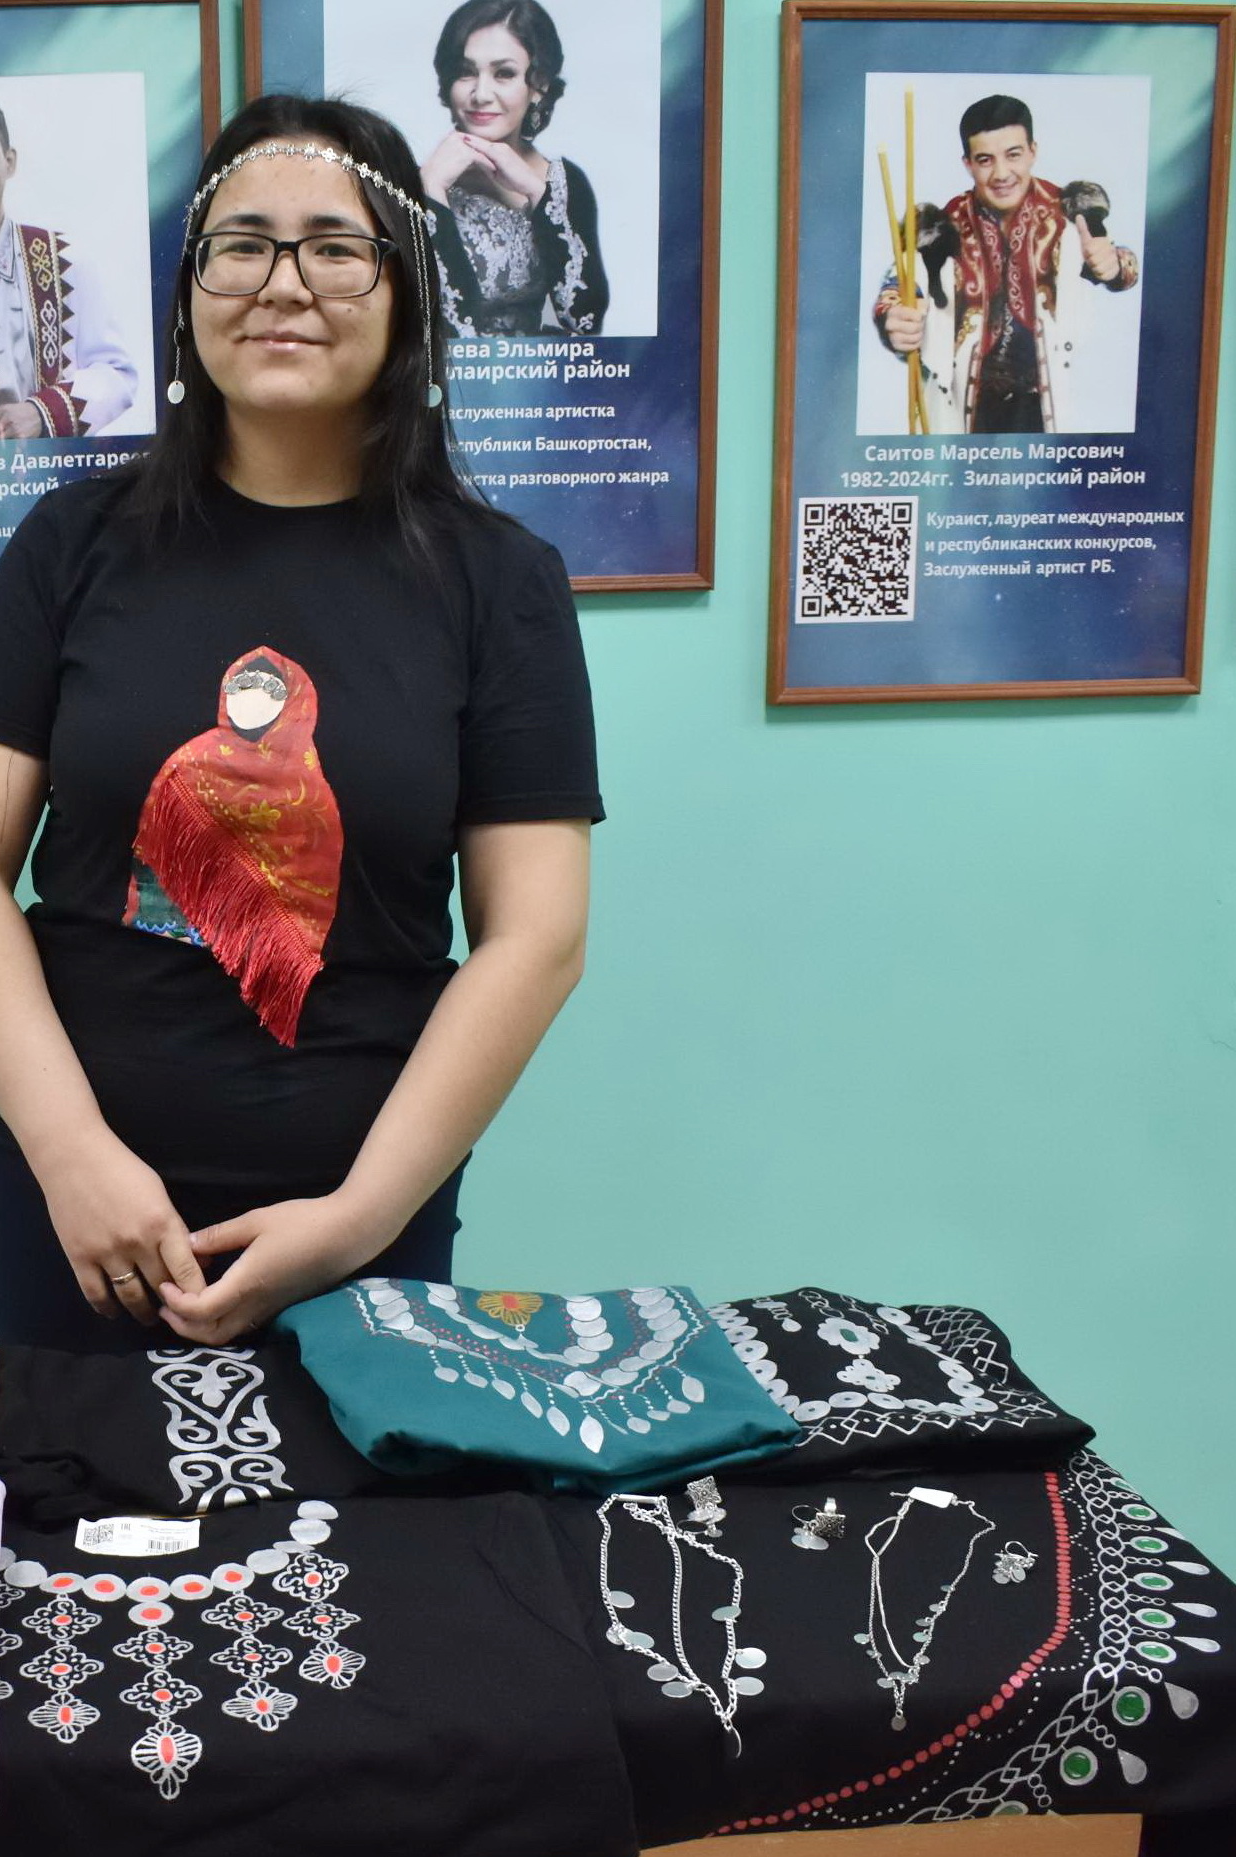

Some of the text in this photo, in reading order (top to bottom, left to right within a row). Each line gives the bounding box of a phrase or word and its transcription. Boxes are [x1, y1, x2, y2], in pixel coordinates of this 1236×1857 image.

[497, 340, 596, 362] Эльмира
[564, 359, 630, 383] район
[545, 405, 616, 421] артистка
[535, 436, 652, 453] Башкортостан,
[864, 443, 1125, 464] Саитов Марсель Марсович
[510, 472, 616, 488] разговорного
[618, 471, 669, 486] жанра
[840, 467, 1146, 489] 1982-2024гг. Зилаирский район
[926, 510, 1185, 529] Кураист, лауреат международных
[924, 536, 1157, 555] и республиканских конкурсов,
[923, 559, 1116, 579] Заслуженный артист РБ.
